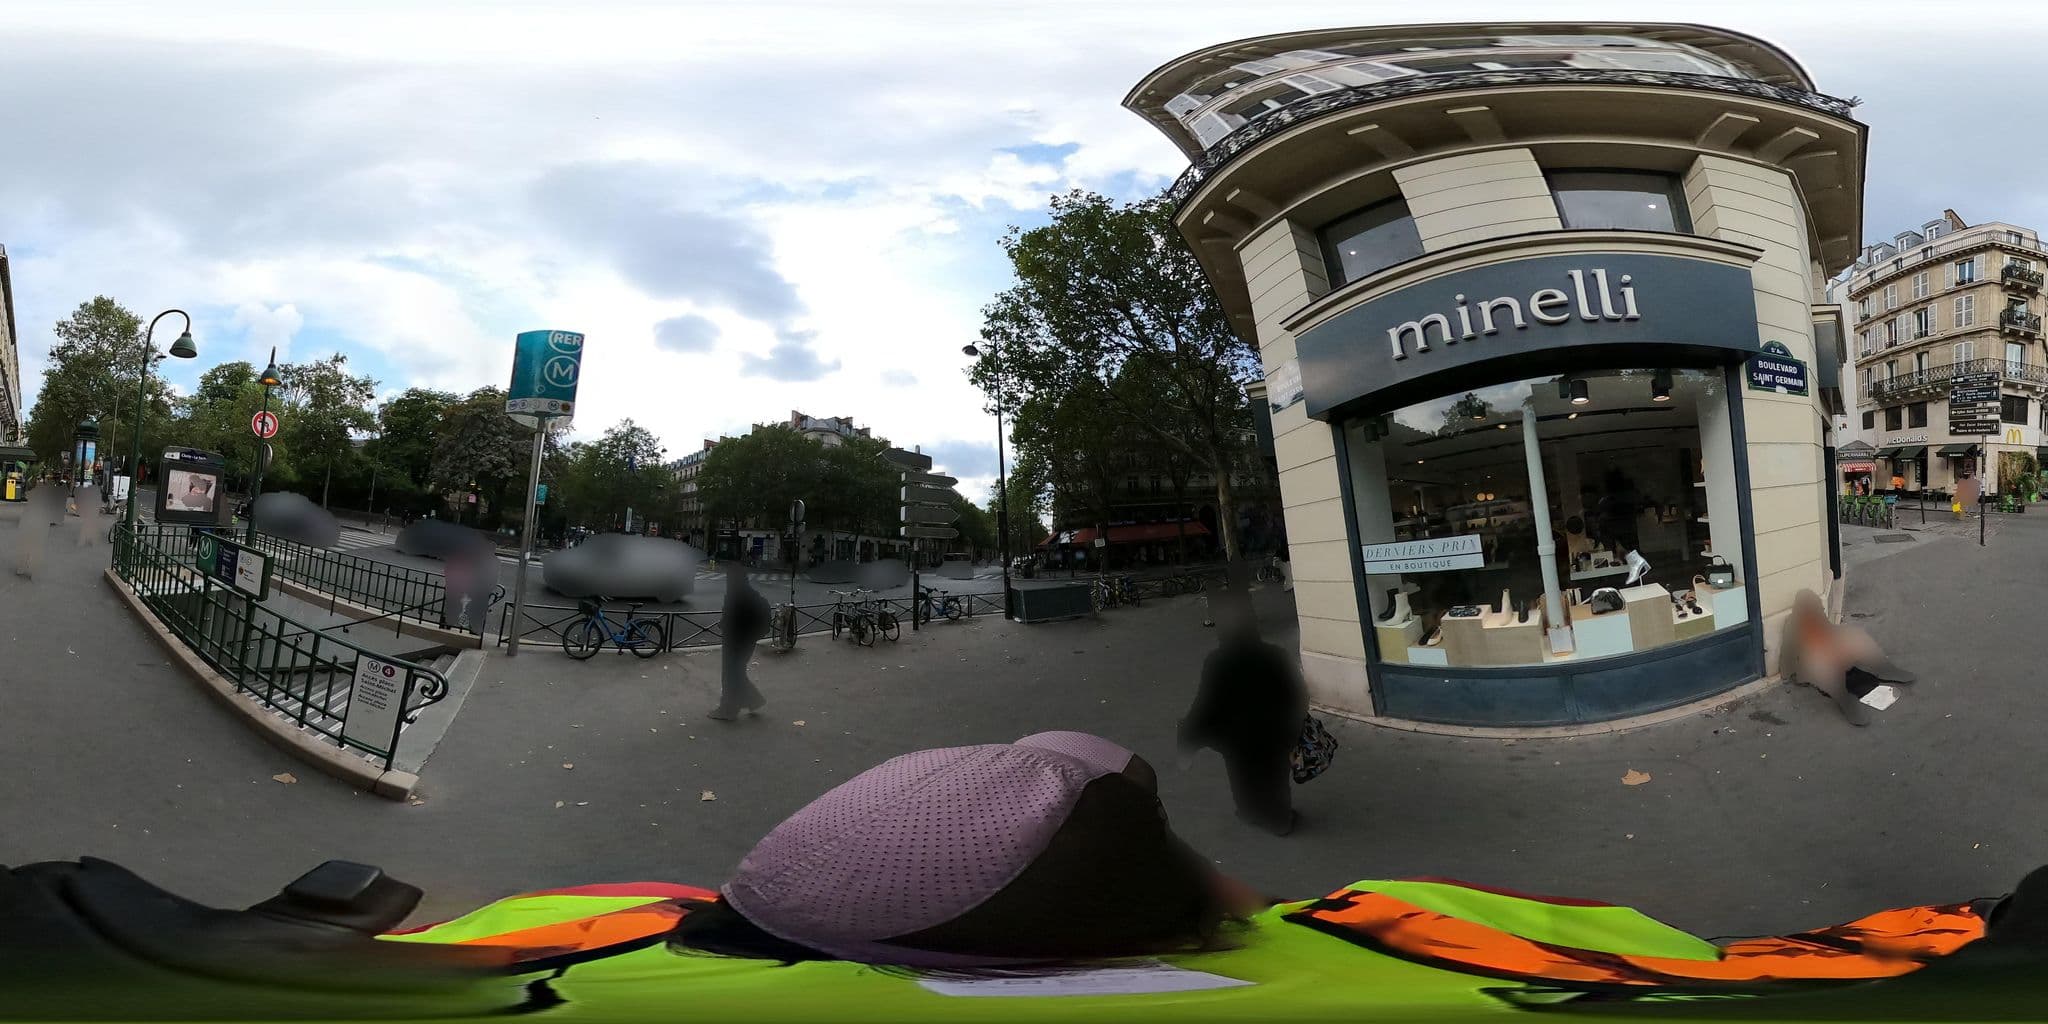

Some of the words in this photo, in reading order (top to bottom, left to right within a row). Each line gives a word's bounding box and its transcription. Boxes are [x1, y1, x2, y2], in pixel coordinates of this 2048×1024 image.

[1387, 268, 1641, 360] minelli
[553, 333, 582, 346] RER
[552, 361, 575, 380] M
[1758, 361, 1798, 374] BOULEVARD
[1753, 372, 1773, 383] SAINT
[1775, 375, 1804, 387] GERMAIN
[1366, 544, 1434, 559] DERNIERS
[1405, 560, 1454, 569] BOUTIQUE
